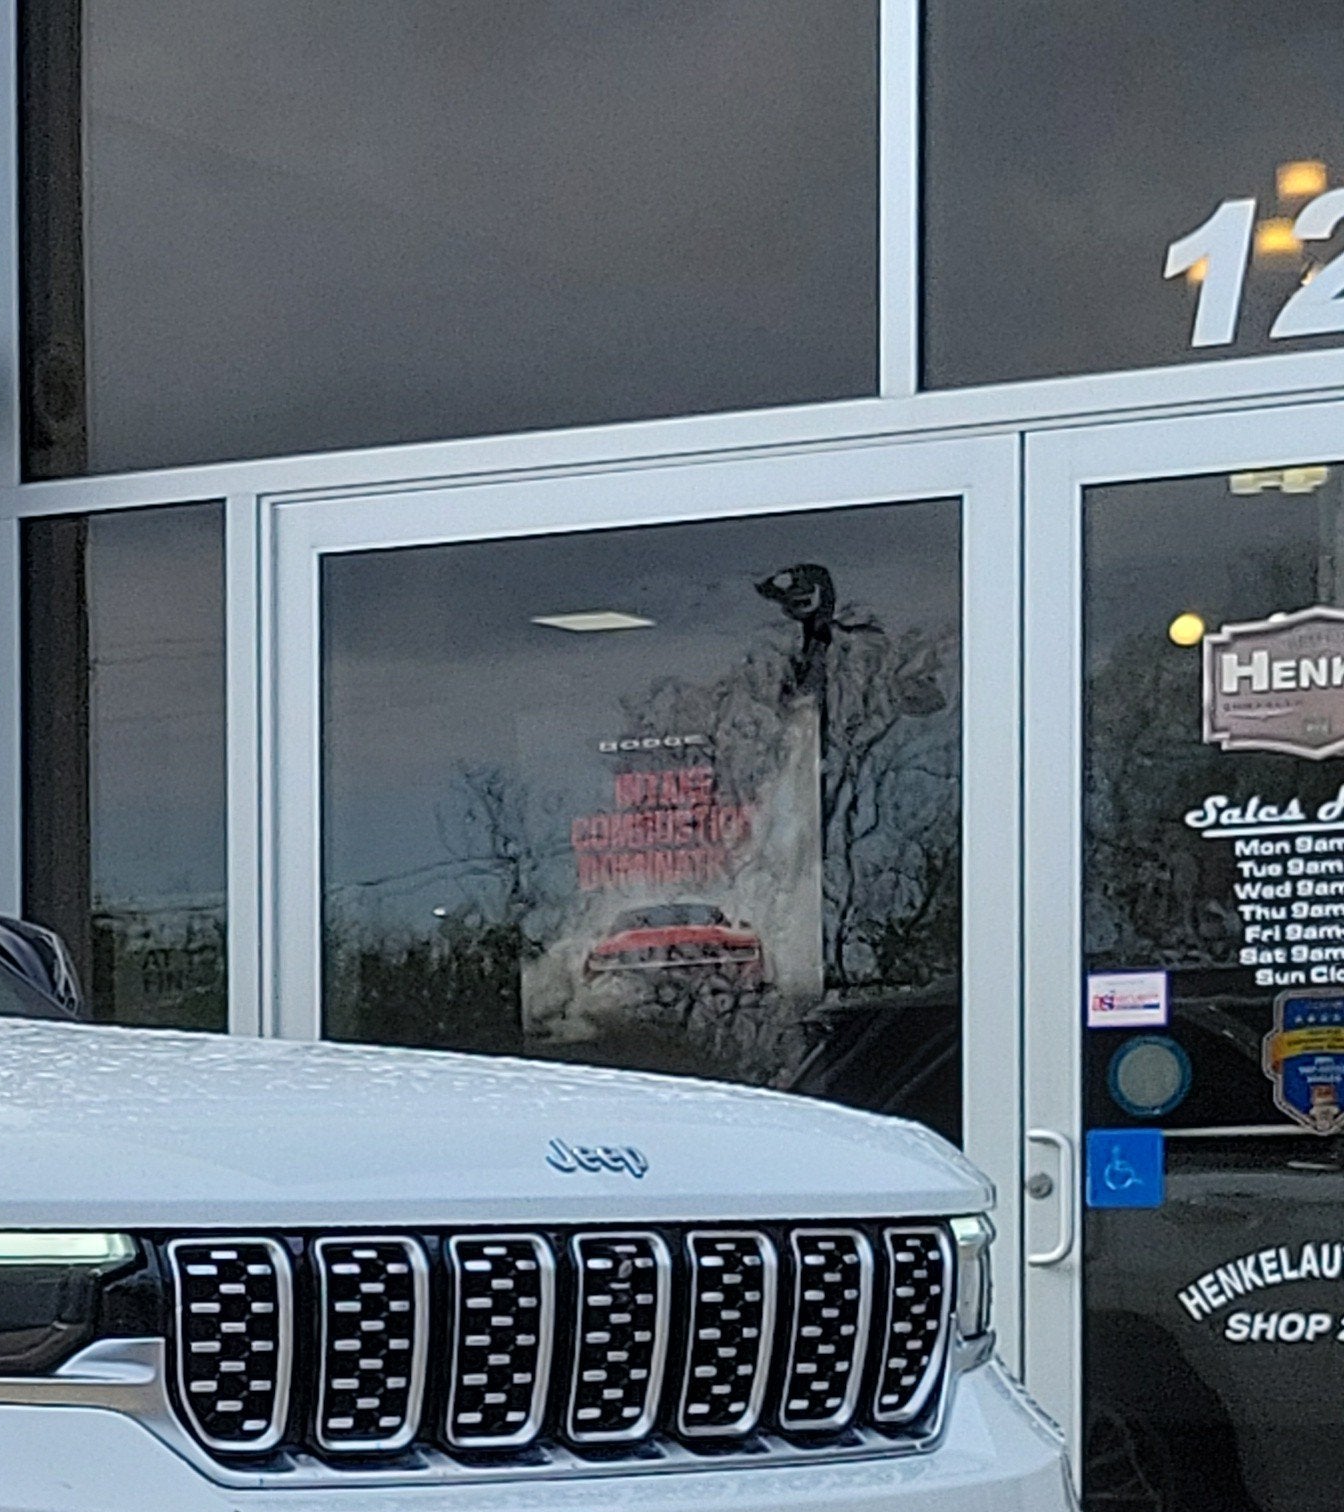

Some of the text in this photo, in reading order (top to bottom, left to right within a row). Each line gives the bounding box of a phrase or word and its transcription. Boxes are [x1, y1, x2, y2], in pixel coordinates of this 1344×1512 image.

[1185, 795, 1306, 828] Sales
[1234, 835, 1344, 857] Mon 9am
[1236, 857, 1344, 878] Tue 9am
[1233, 880, 1292, 900] Wed
[1237, 901, 1344, 922] Thu 9am
[1244, 924, 1281, 943] Fri
[1239, 945, 1344, 965] Sat 9am
[1255, 968, 1306, 986] Sun
[545, 1137, 649, 1179] Jeep
[1177, 1243, 1344, 1321] HENKELAU
[1224, 1312, 1332, 1342] SHOP
